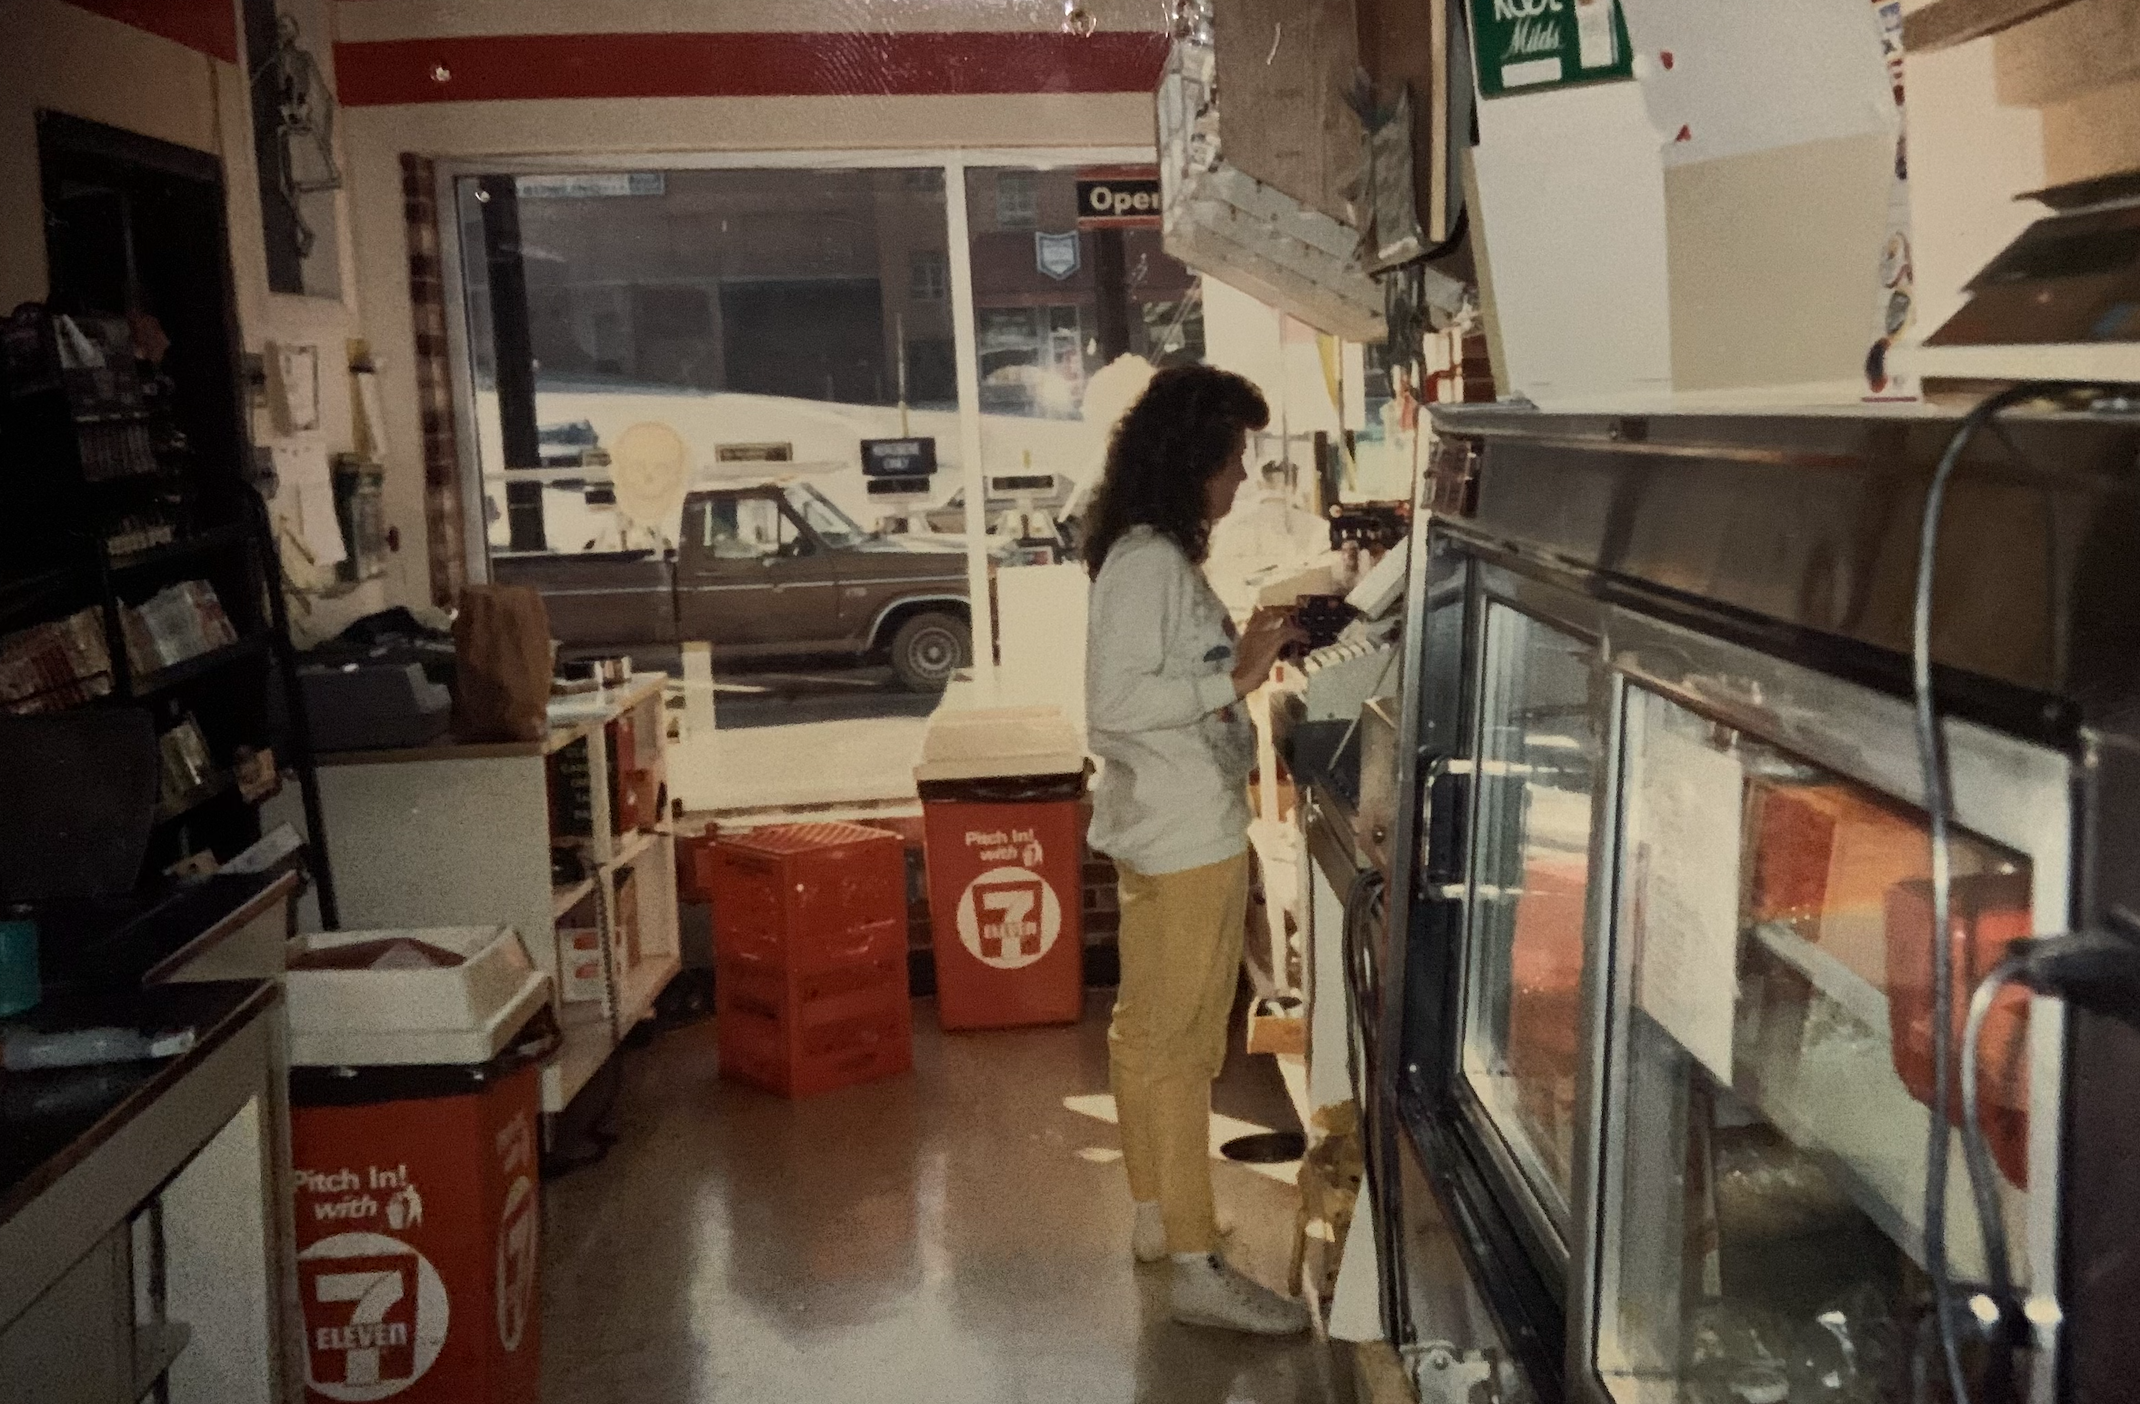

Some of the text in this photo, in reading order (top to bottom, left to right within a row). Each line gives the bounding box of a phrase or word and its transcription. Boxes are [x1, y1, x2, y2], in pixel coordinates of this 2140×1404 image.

[1502, 16, 1565, 58] Milds
[965, 831, 1008, 846] Pitch
[980, 845, 1018, 861] with
[982, 890, 1034, 958] 7
[369, 1164, 407, 1189] In!
[314, 1194, 377, 1220] with
[315, 1271, 404, 1385] 7
